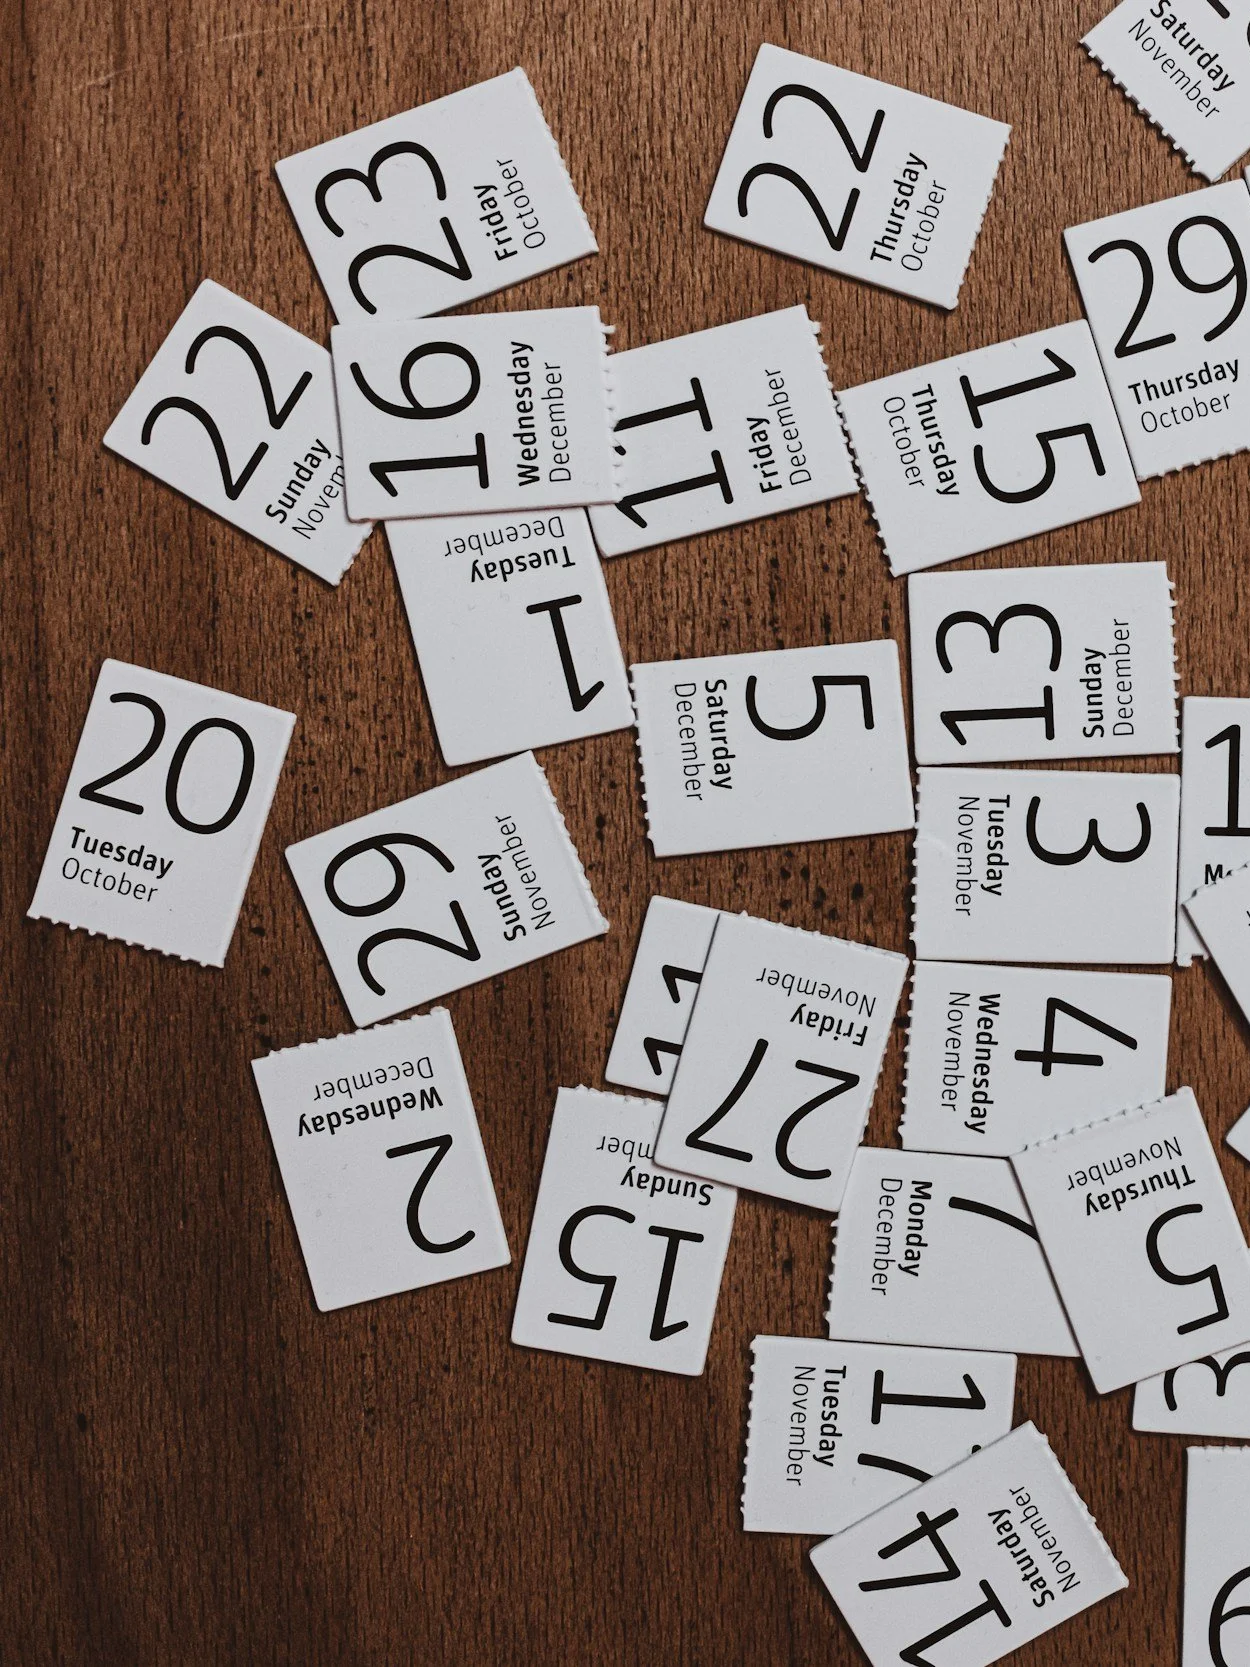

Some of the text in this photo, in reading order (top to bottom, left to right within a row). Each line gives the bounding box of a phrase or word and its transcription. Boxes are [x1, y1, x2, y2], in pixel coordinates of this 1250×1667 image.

[1128, 19, 1219, 117] November
[1150, 0, 1235, 91] Saturday
[497, 160, 545, 249] October
[738, 84, 885, 251] 22
[870, 152, 927, 261] Thursday
[315, 141, 472, 315] 23
[474, 185, 518, 261] Friday
[901, 180, 946, 271] October
[1088, 215, 1247, 358] 29
[141, 326, 312, 501] 22
[350, 341, 489, 497] 16
[507, 341, 540, 486] Wednesday
[541, 362, 571, 482] December
[765, 370, 811, 485] December
[959, 348, 1106, 504] 15
[1128, 359, 1238, 404] Thursday
[1141, 394, 1229, 432] October
[265, 439, 331, 524] Sunday
[608, 377, 734, 528] 11
[746, 418, 782, 493] Friday
[884, 397, 924, 486] October
[912, 384, 959, 495] Thursday
[292, 456, 346, 539] Novem
[445, 516, 564, 557] December
[471, 546, 576, 582] Tuesday
[526, 594, 604, 712] 1
[936, 604, 1062, 745] 13
[1079, 648, 1106, 738] Sunday
[1109, 619, 1134, 736] December
[674, 683, 705, 800] December
[705, 679, 736, 789] Saturday
[745, 675, 874, 741] 5
[79, 692, 255, 834] 20
[62, 858, 158, 902] October
[71, 826, 173, 879] Tuesday
[495, 816, 555, 930] November
[956, 797, 980, 916] November
[980, 794, 1010, 896] Tuesday
[1026, 796, 1151, 866] 3
[324, 833, 481, 996] 29
[478, 854, 526, 941] Sunday
[756, 968, 876, 1017] November
[790, 1003, 868, 1046] Friday
[1014, 997, 1137, 1076] 4
[314, 1057, 433, 1101] December
[941, 992, 970, 1111] November
[964, 994, 1001, 1134] Wednesday
[299, 1086, 443, 1137] Wednesday
[685, 1038, 860, 1180] 27
[386, 1134, 475, 1254] 2
[620, 1166, 714, 1206] Sunday
[1068, 1137, 1182, 1190] November
[1086, 1165, 1196, 1216] Thursday
[547, 1205, 704, 1341] 15
[871, 1178, 903, 1295] December
[898, 1181, 932, 1277] Monday
[1146, 1204, 1229, 1335] 5
[786, 1366, 816, 1486] November
[813, 1365, 846, 1467] Tuesday
[859, 1508, 1012, 1667] 14
[988, 1509, 1055, 1607] Saturday
[1009, 1487, 1080, 1593] November
